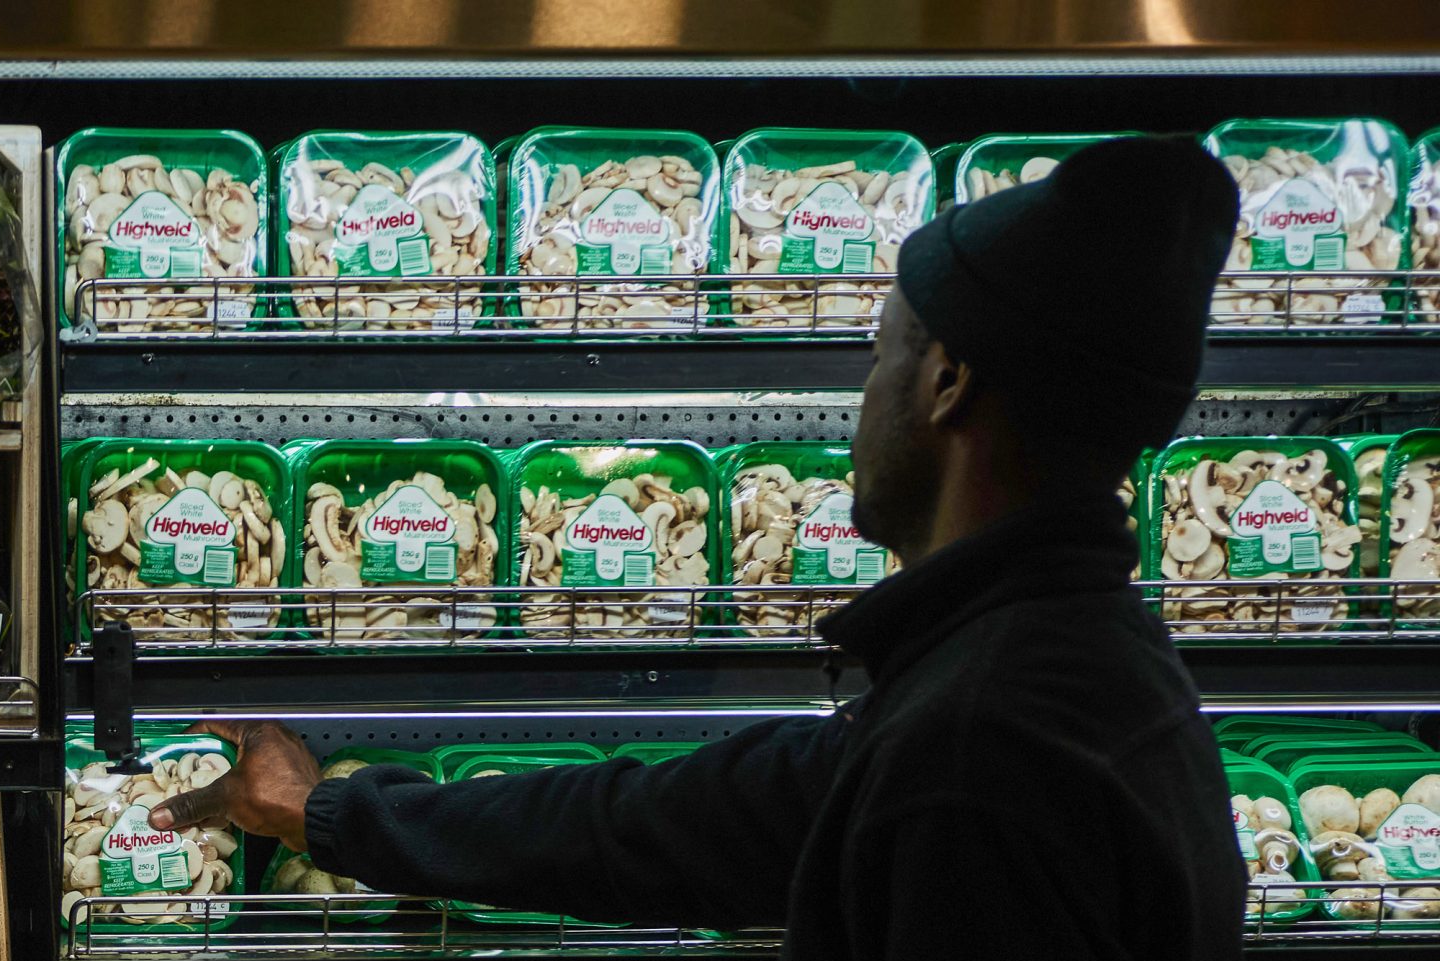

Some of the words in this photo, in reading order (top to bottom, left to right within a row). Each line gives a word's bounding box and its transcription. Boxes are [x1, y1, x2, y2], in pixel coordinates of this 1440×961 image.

[342, 211, 415, 236] Highveld
[793, 210, 867, 231] Highveld
[1262, 208, 1336, 229] Highveld
[116, 221, 192, 239] Highveld
[588, 219, 662, 238] Highveld
[375, 250, 389, 258] 250
[616, 252, 630, 260] 250
[180, 502, 204, 511] Sliced
[398, 500, 423, 508] Sliced
[180, 510, 203, 518] White
[399, 507, 422, 516] White
[1237, 508, 1309, 528] Highveld
[153, 517, 230, 538] Highveld
[373, 516, 448, 535] Highveld
[804, 523, 860, 542] Highve
[1268, 523, 1309, 532] Mushrooms
[182, 534, 226, 544] Mushrooms
[573, 524, 646, 543] Highveld
[180, 552, 194, 560] 250
[401, 550, 414, 558] 250
[601, 558, 614, 566] 250
[109, 831, 174, 851] Highveld
